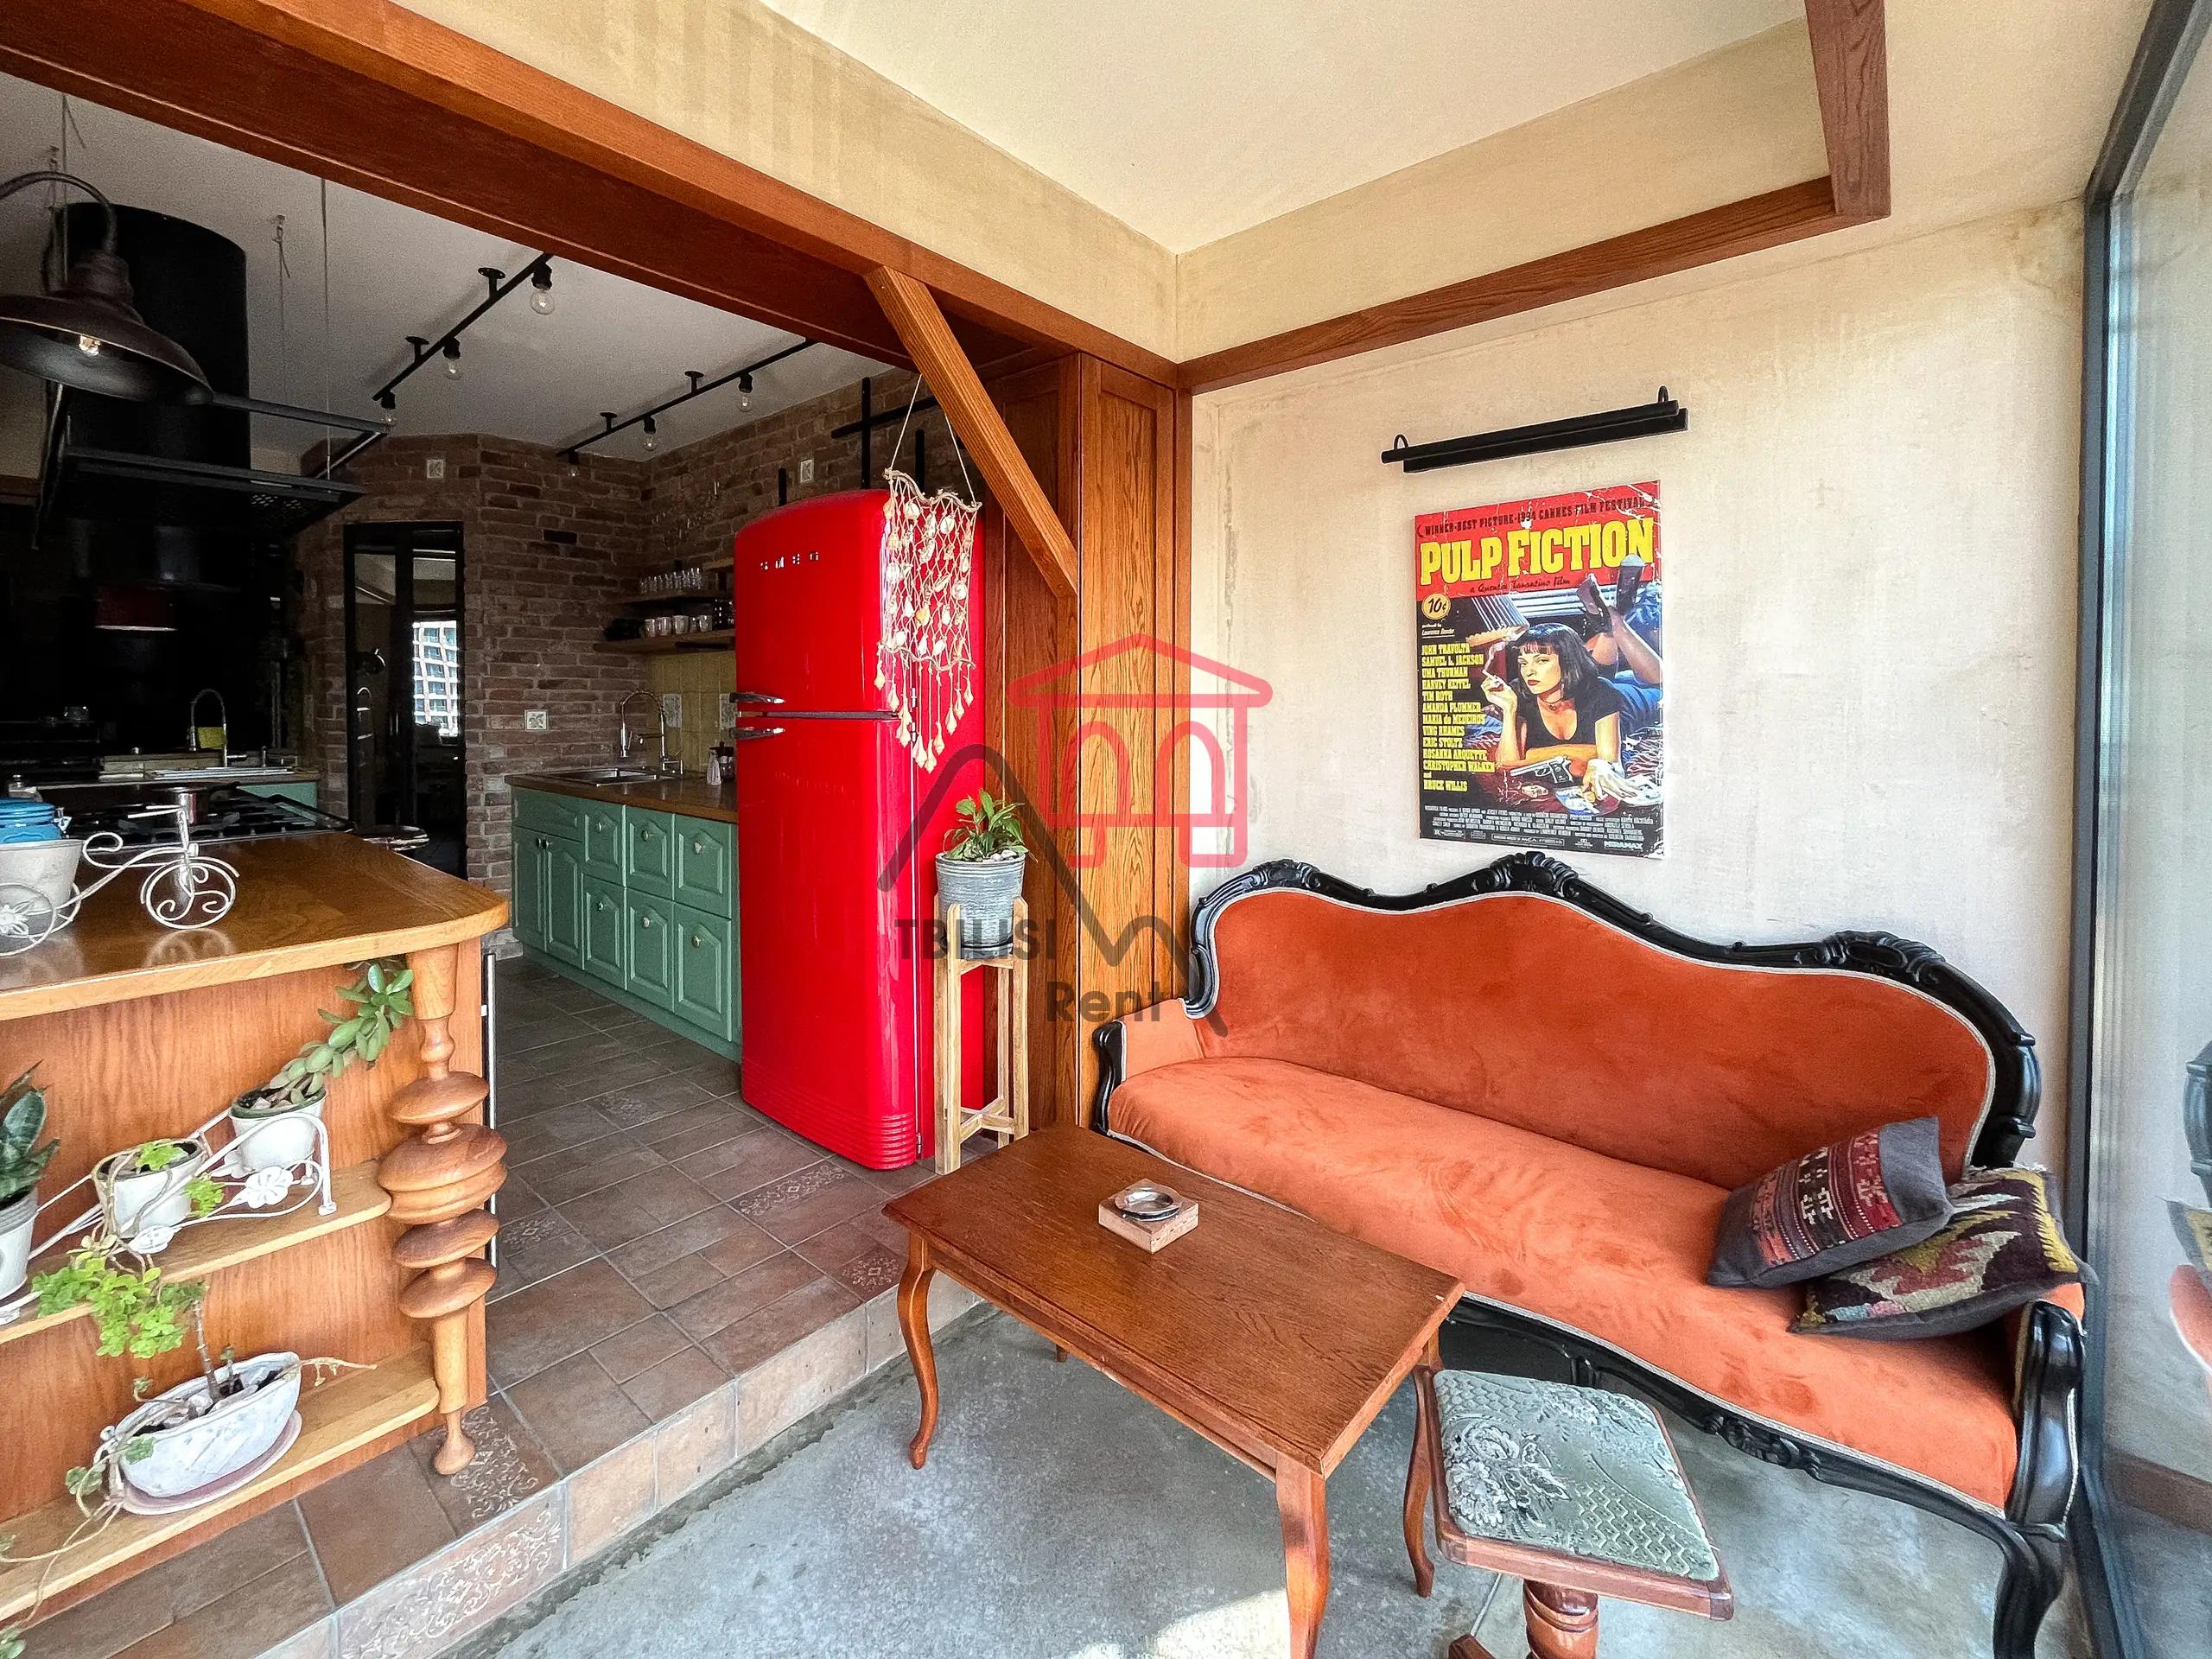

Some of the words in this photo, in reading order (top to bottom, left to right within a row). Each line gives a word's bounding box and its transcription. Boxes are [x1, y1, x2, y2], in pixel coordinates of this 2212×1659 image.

[1539, 505, 1573, 520] CANNES
[1575, 501, 1598, 515] FILM
[1420, 537, 1503, 586] PULP
[1507, 517, 1655, 577] FICTION
[1421, 645, 1437, 655] JOHN
[1439, 643, 1470, 654] TRAVOLTA
[1421, 656, 1446, 667] SAMUEL
[1455, 654, 1484, 664] JACKSON
[1421, 668, 1435, 678] UMA
[1437, 666, 1468, 677] THURMAN
[1421, 679, 1446, 690] HARVEY
[1447, 678, 1471, 689] KEITEL
[1422, 691, 1434, 701] TIM
[1435, 690, 1452, 701] ROTH
[1422, 702, 1448, 713] AMANDA
[1449, 702, 1481, 713] PLUMMER
[1422, 726, 1438, 736] VING
[1439, 726, 1465, 736] RHAMES
[1423, 737, 1438, 747] ERIC
[1439, 737, 1463, 747] STOLTZ
[1423, 748, 1452, 760] ROSANNA
[1453, 749, 1487, 760] ARQUETTE
[1423, 760, 1467, 772] CHRISTOPHER
[1468, 761, 1496, 772] WALKEN
[1423, 779, 1445, 790] BRUCE
[1445, 780, 1467, 791] WILLIS
